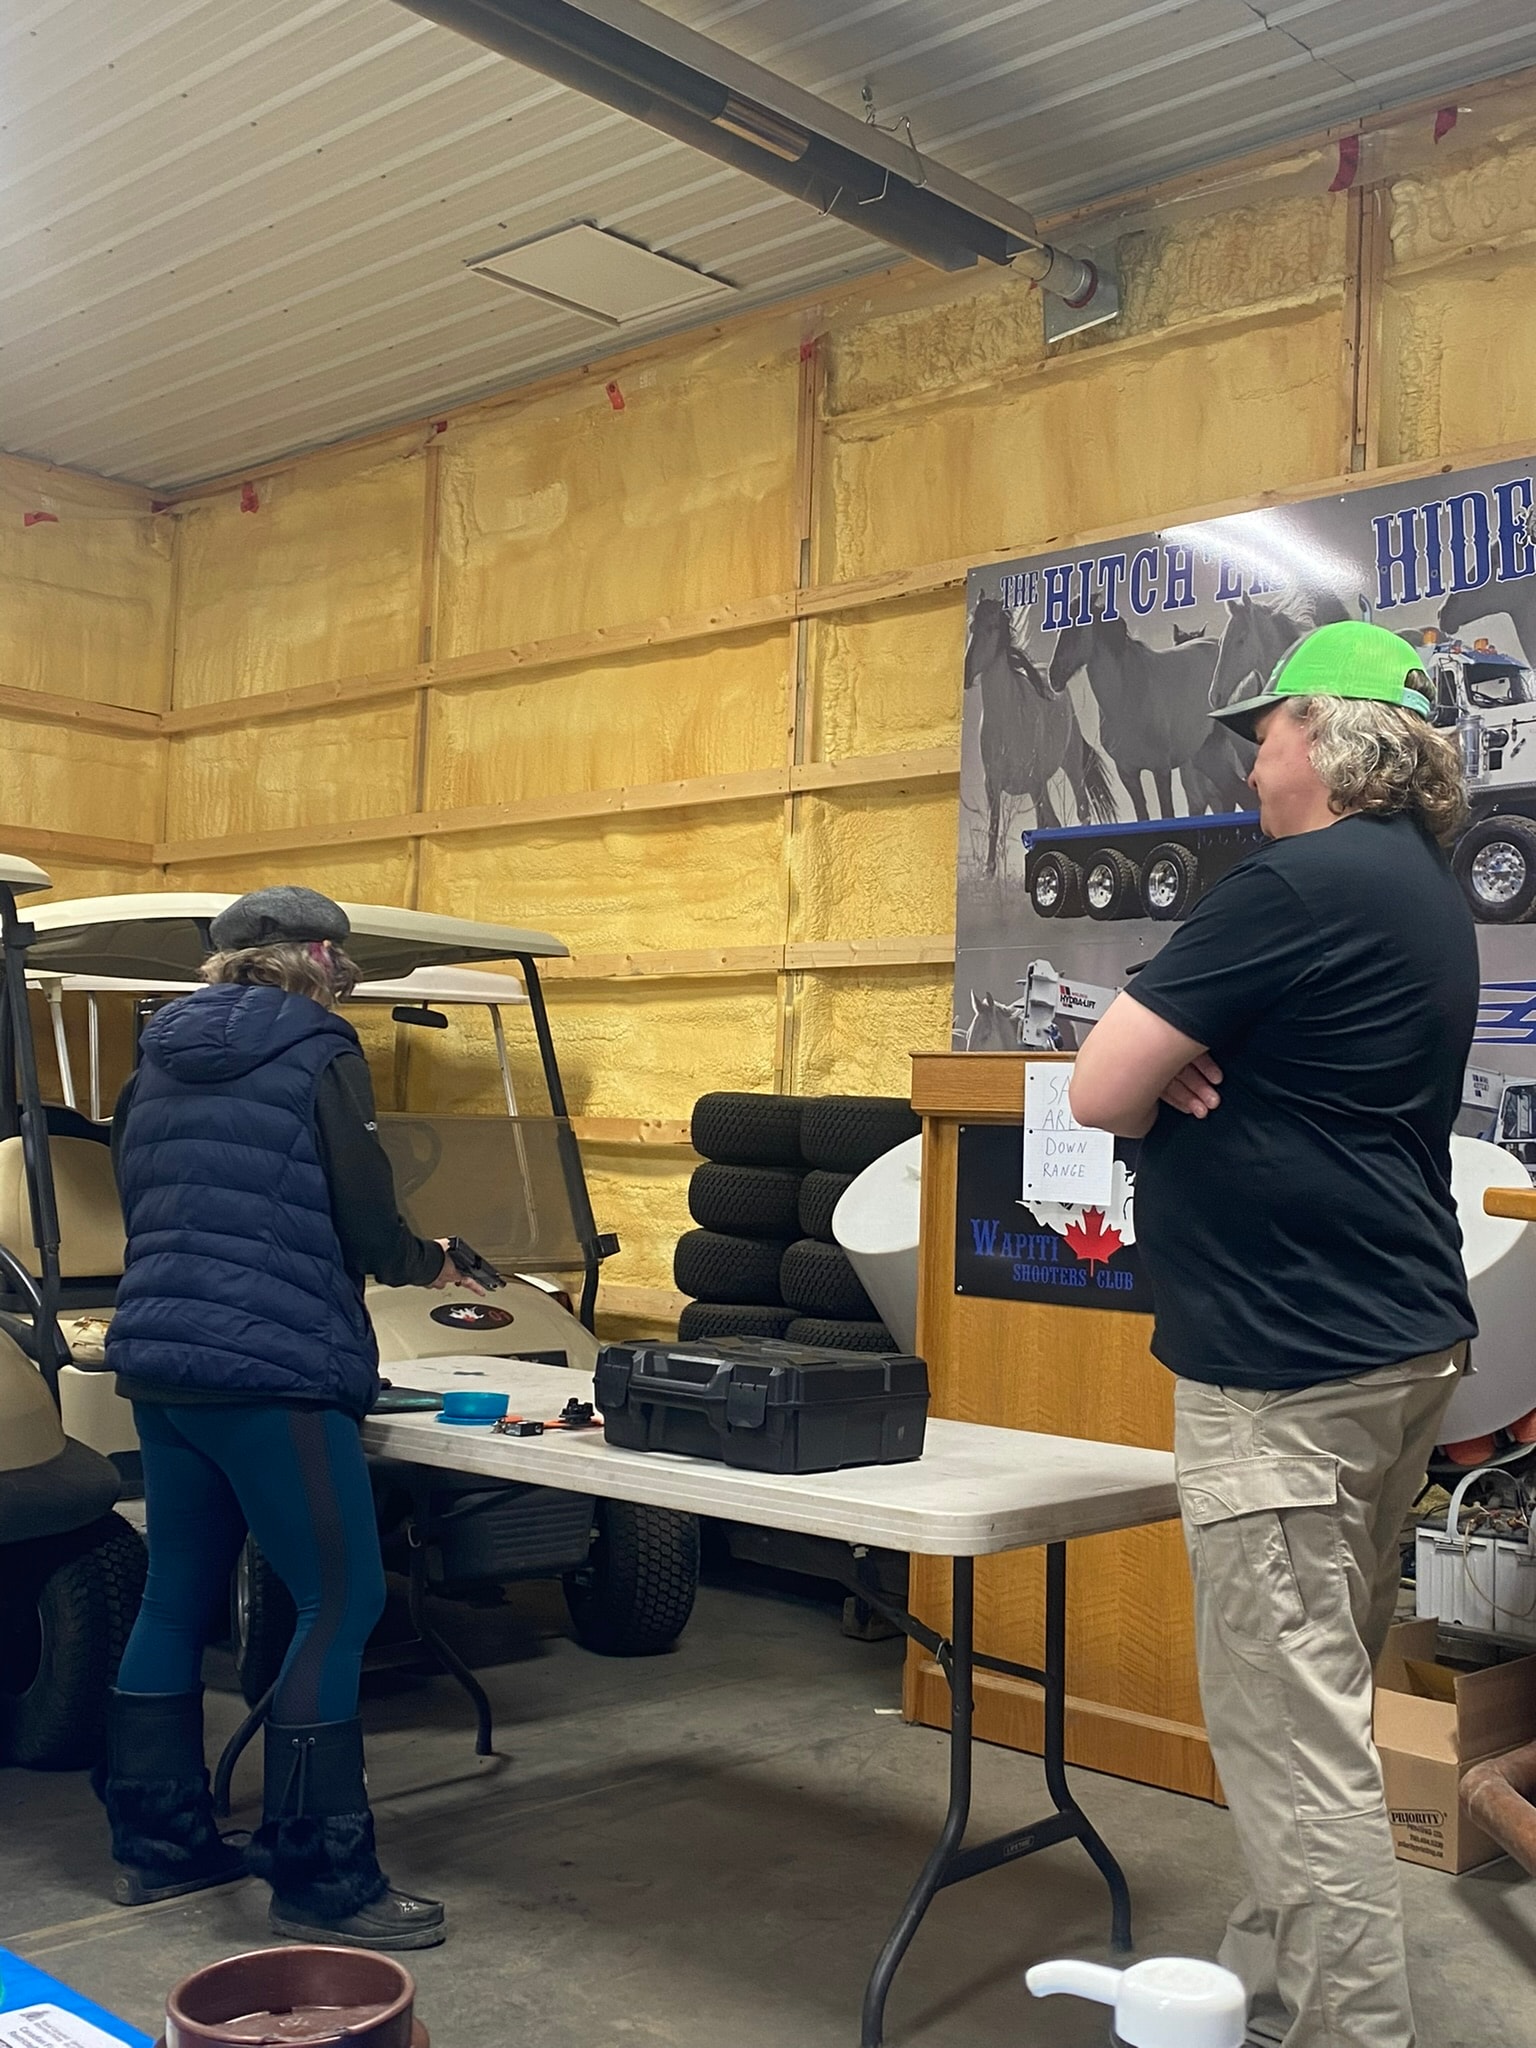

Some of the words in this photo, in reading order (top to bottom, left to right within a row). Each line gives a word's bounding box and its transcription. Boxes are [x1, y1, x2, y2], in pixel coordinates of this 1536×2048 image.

[1001, 571, 1039, 610] THE
[1041, 543, 1197, 632] HITCH
[1371, 477, 1536, 611] HIDE
[1045, 1136, 1087, 1156] DOWN
[1042, 1162, 1086, 1178] RANGE
[970, 1218, 1059, 1262] WAPITI
[1013, 1263, 1087, 1287] SHOOTERS
[1096, 1270, 1134, 1291] CLUB
[1391, 1812, 1439, 1824] PRIORITY
